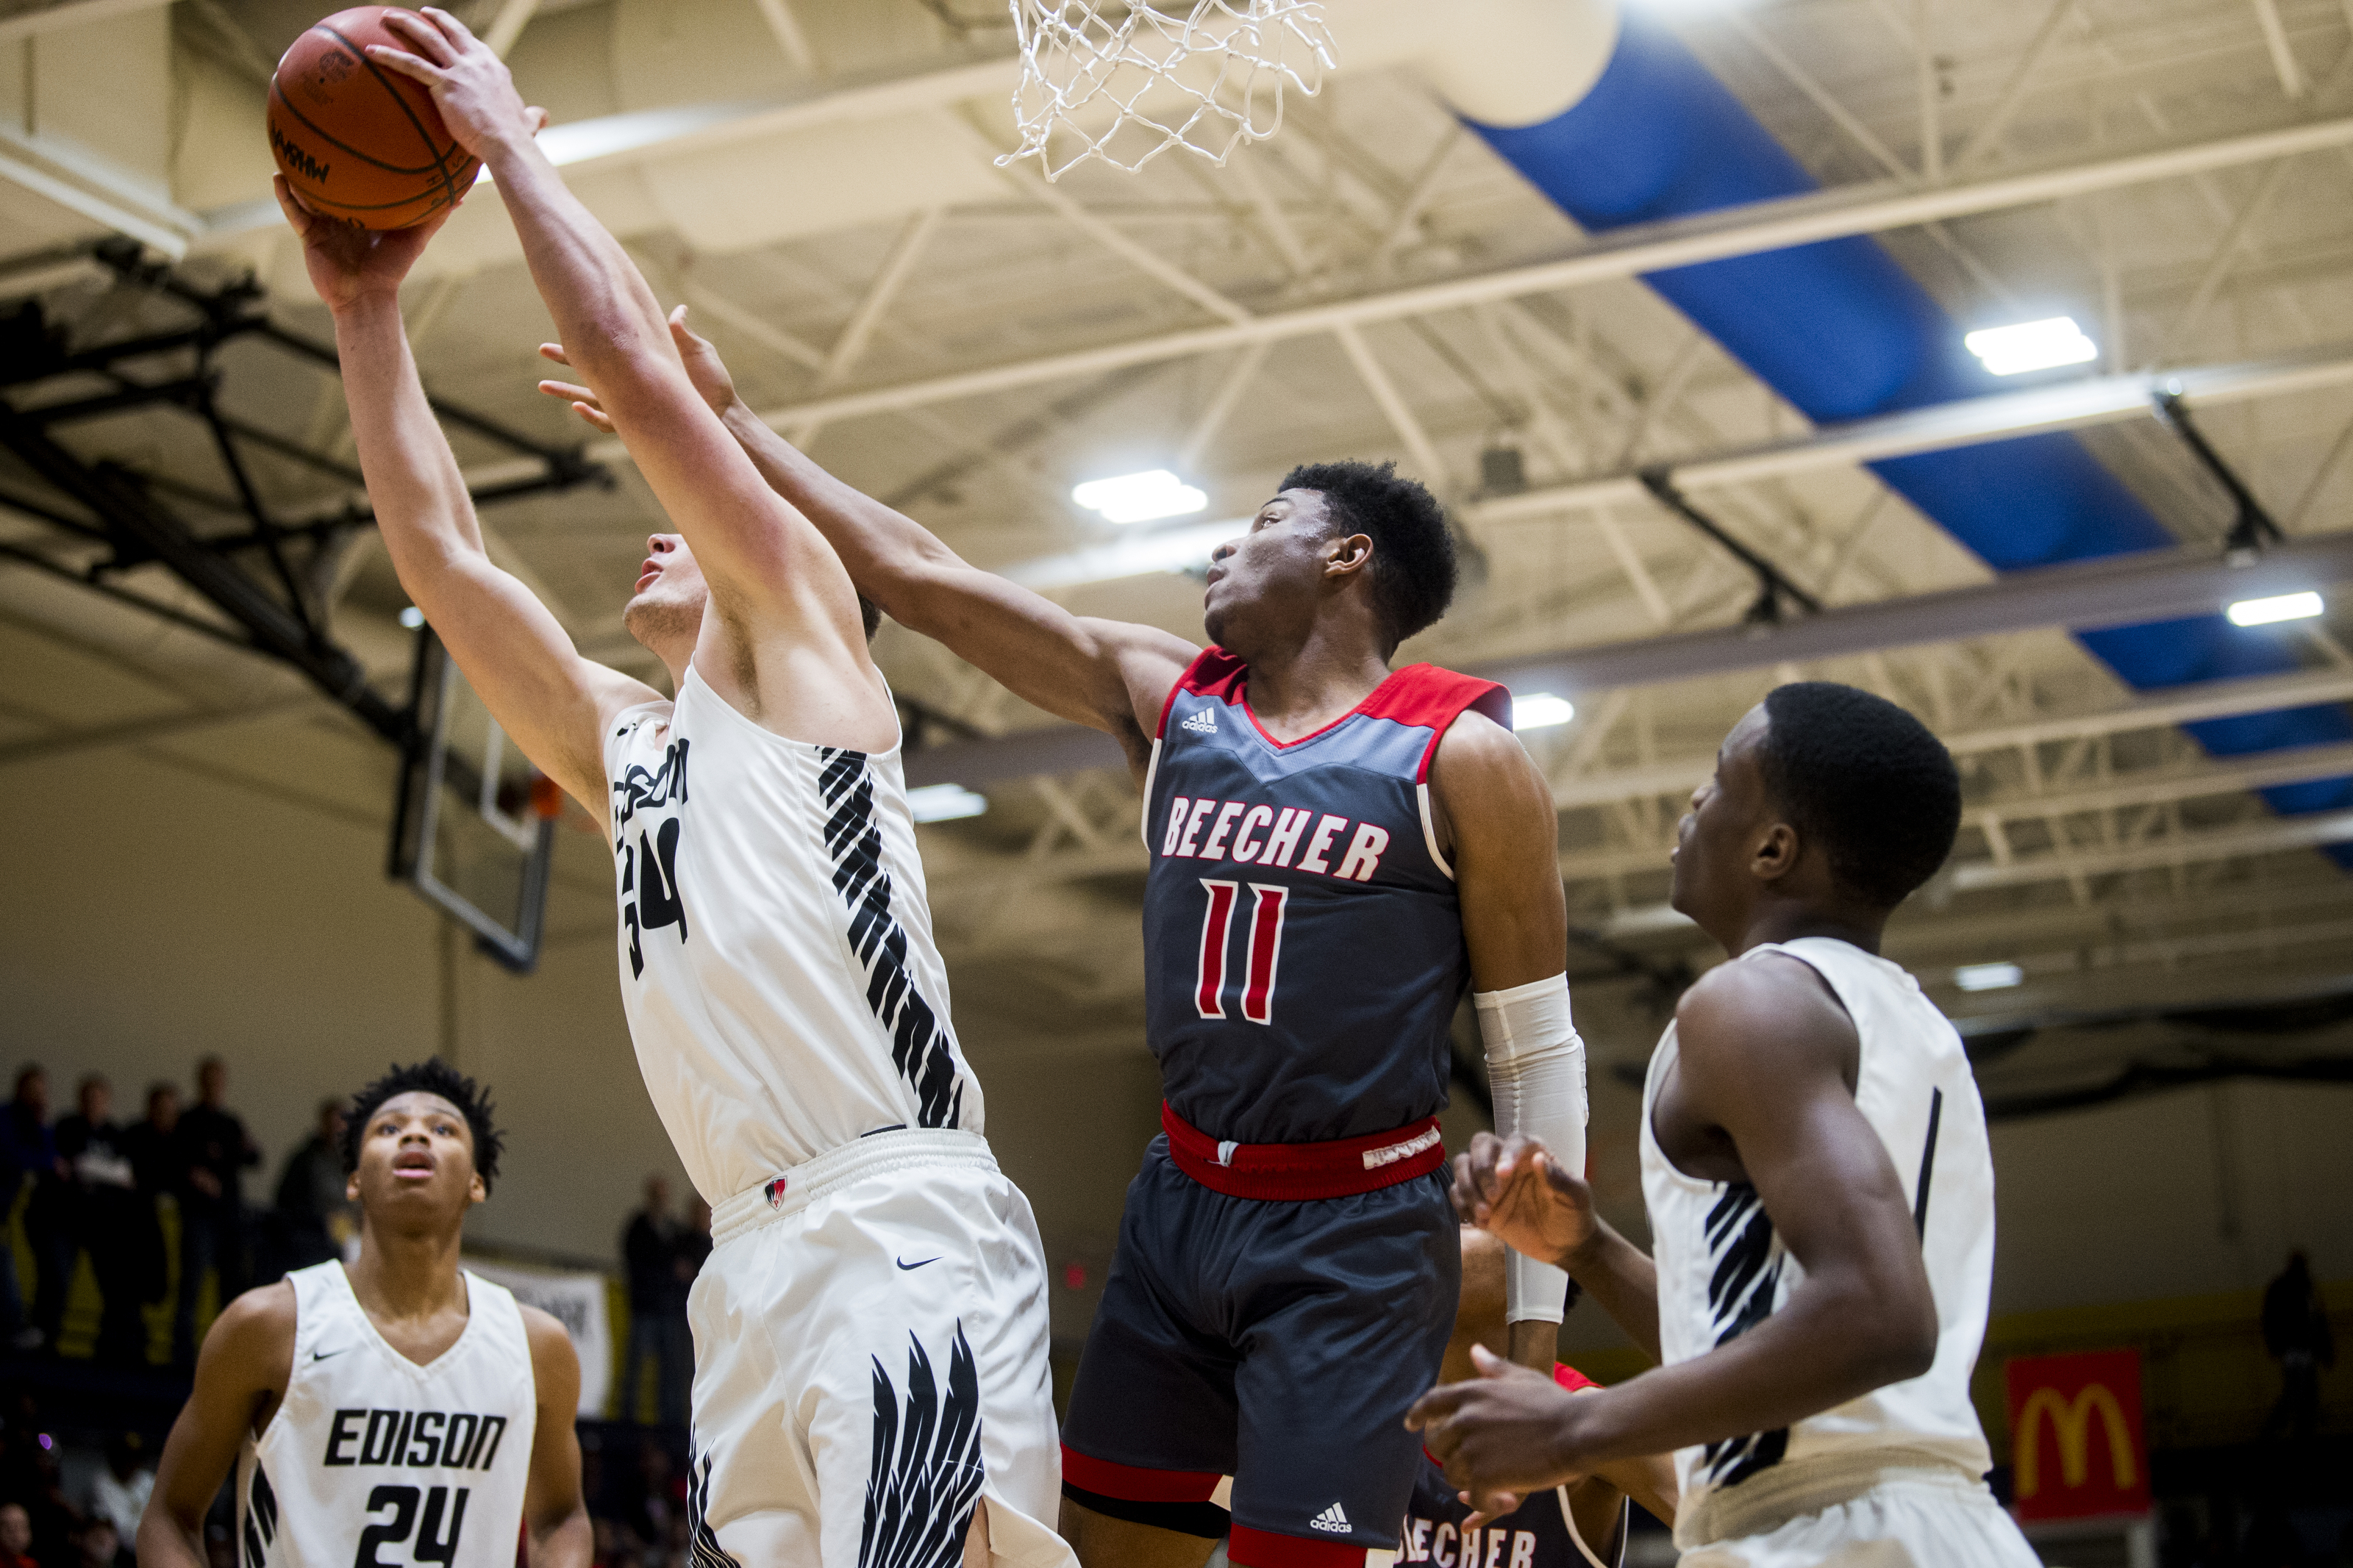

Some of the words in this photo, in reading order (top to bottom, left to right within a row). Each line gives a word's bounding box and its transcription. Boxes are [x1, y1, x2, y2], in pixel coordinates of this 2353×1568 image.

[1182, 720, 1218, 734] adidas
[1161, 796, 1390, 882] BEECHER
[1194, 878, 1289, 1025] 11
[324, 1408, 507, 1472] EDISON
[353, 1484, 471, 1568] 24
[1310, 1519, 1352, 1533] adidas
